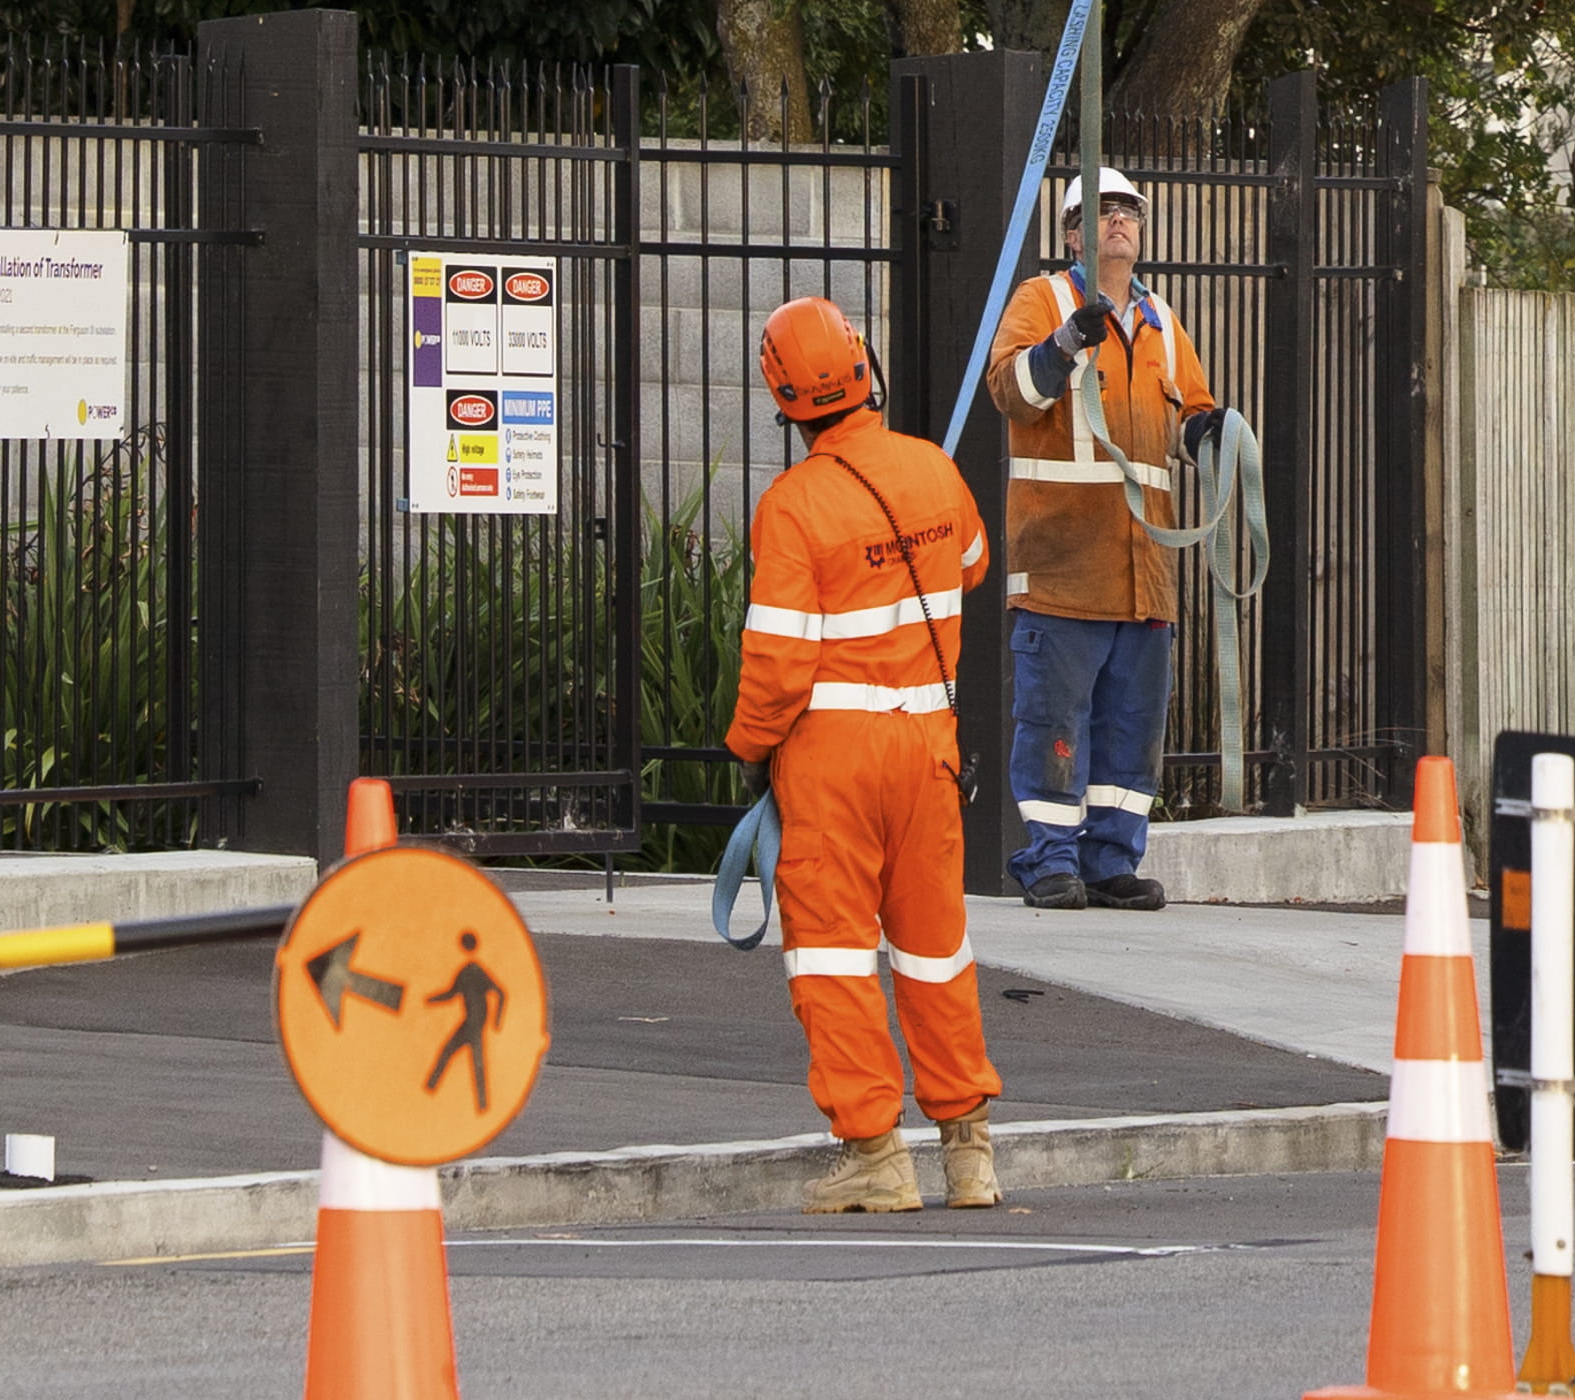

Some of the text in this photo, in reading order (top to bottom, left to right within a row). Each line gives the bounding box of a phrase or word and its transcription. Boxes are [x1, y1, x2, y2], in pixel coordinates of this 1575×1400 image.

[1059, 4, 1087, 59] LASHING
[1042, 57, 1071, 118] CAPACITY
[1029, 116, 1054, 167] 2500KG
[33, 256, 45, 278] of
[45, 257, 104, 280] Transformer
[456, 277, 486, 293] DANGER
[512, 279, 542, 295] DANGER
[470, 330, 491, 347] VOLTS
[526, 332, 547, 349] VOLTS
[457, 403, 487, 418] DANGER
[504, 399, 552, 418] MINIMUM PPE
